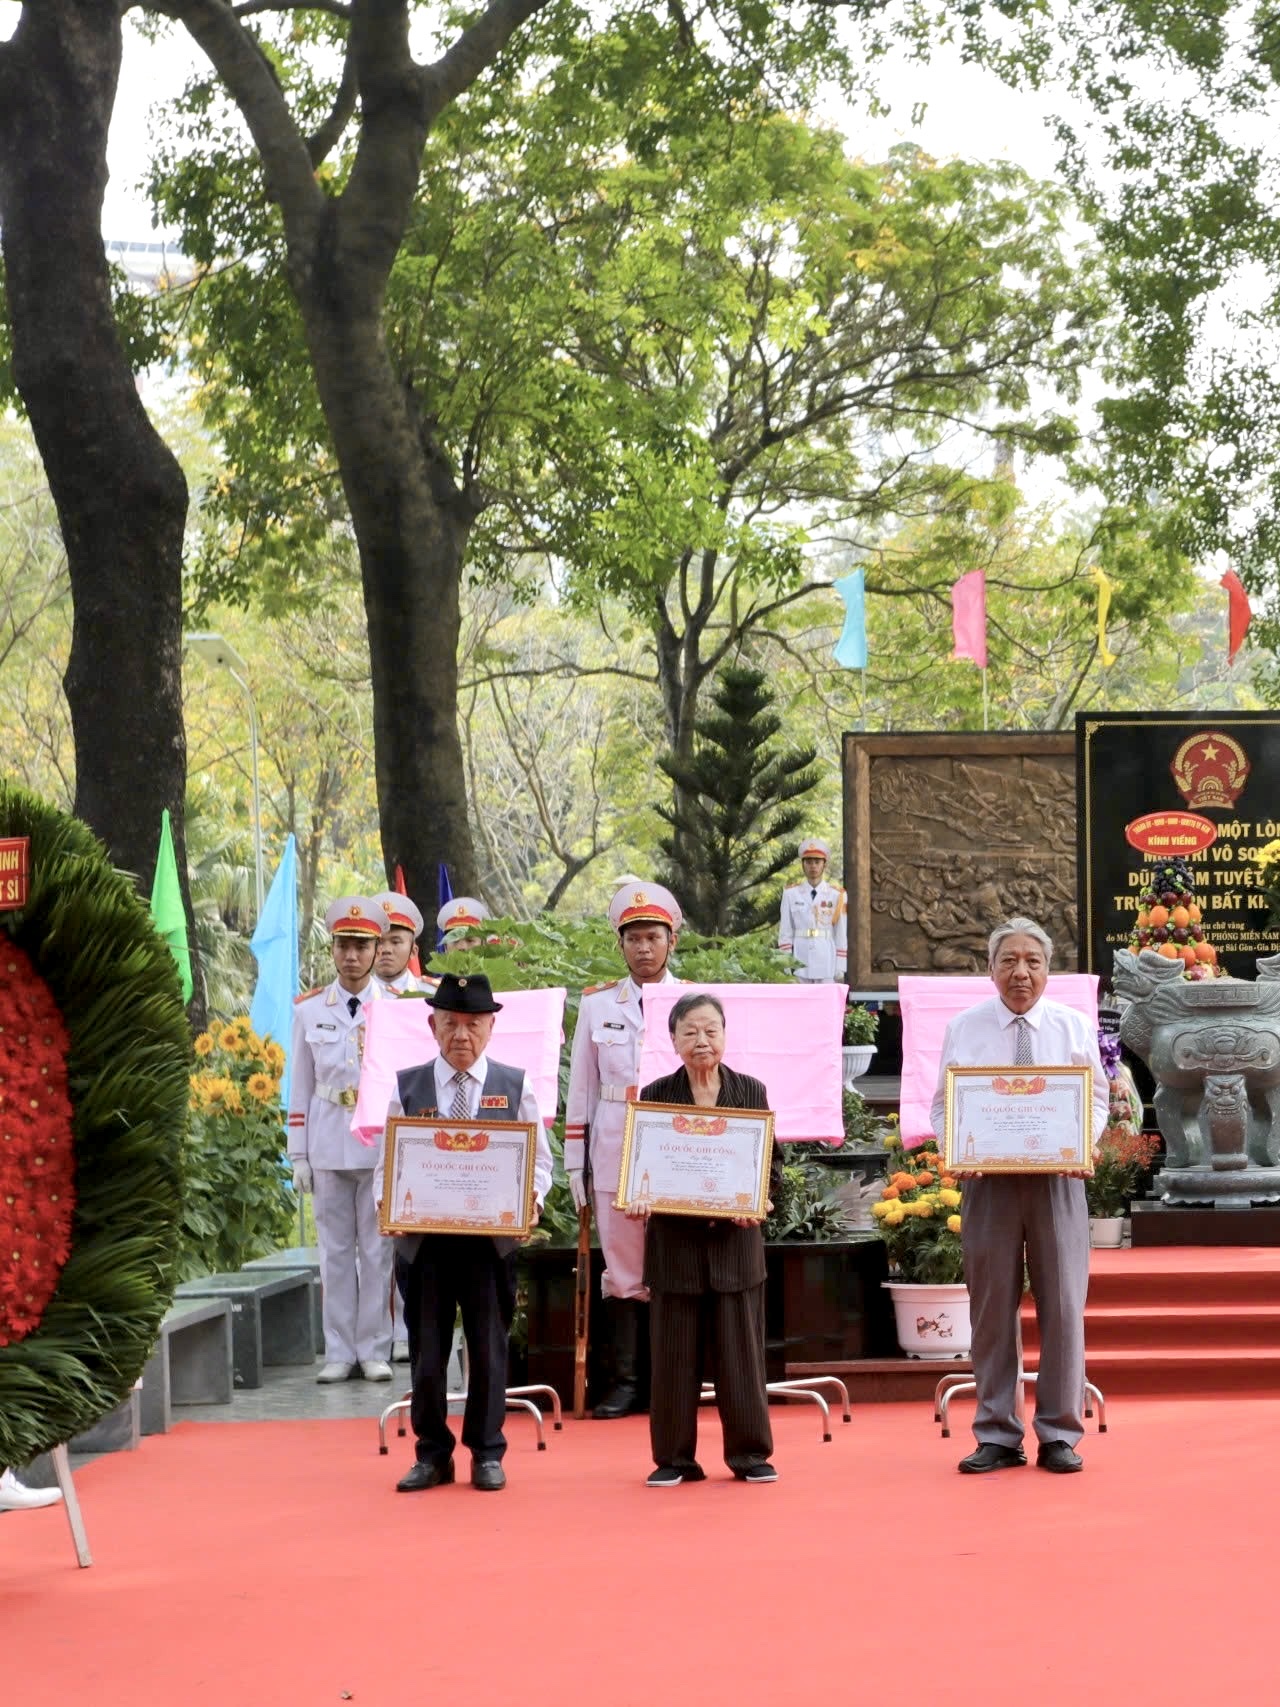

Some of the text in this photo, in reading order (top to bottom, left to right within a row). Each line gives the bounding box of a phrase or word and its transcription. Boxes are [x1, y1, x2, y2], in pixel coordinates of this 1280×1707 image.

[1148, 834, 1197, 846] KÍNH VIẾNG
[1218, 820, 1250, 840] MỘT
[1212, 845, 1233, 862] VÔ
[1214, 867, 1264, 888] TUYỆT
[1212, 890, 1245, 910] BẤT
